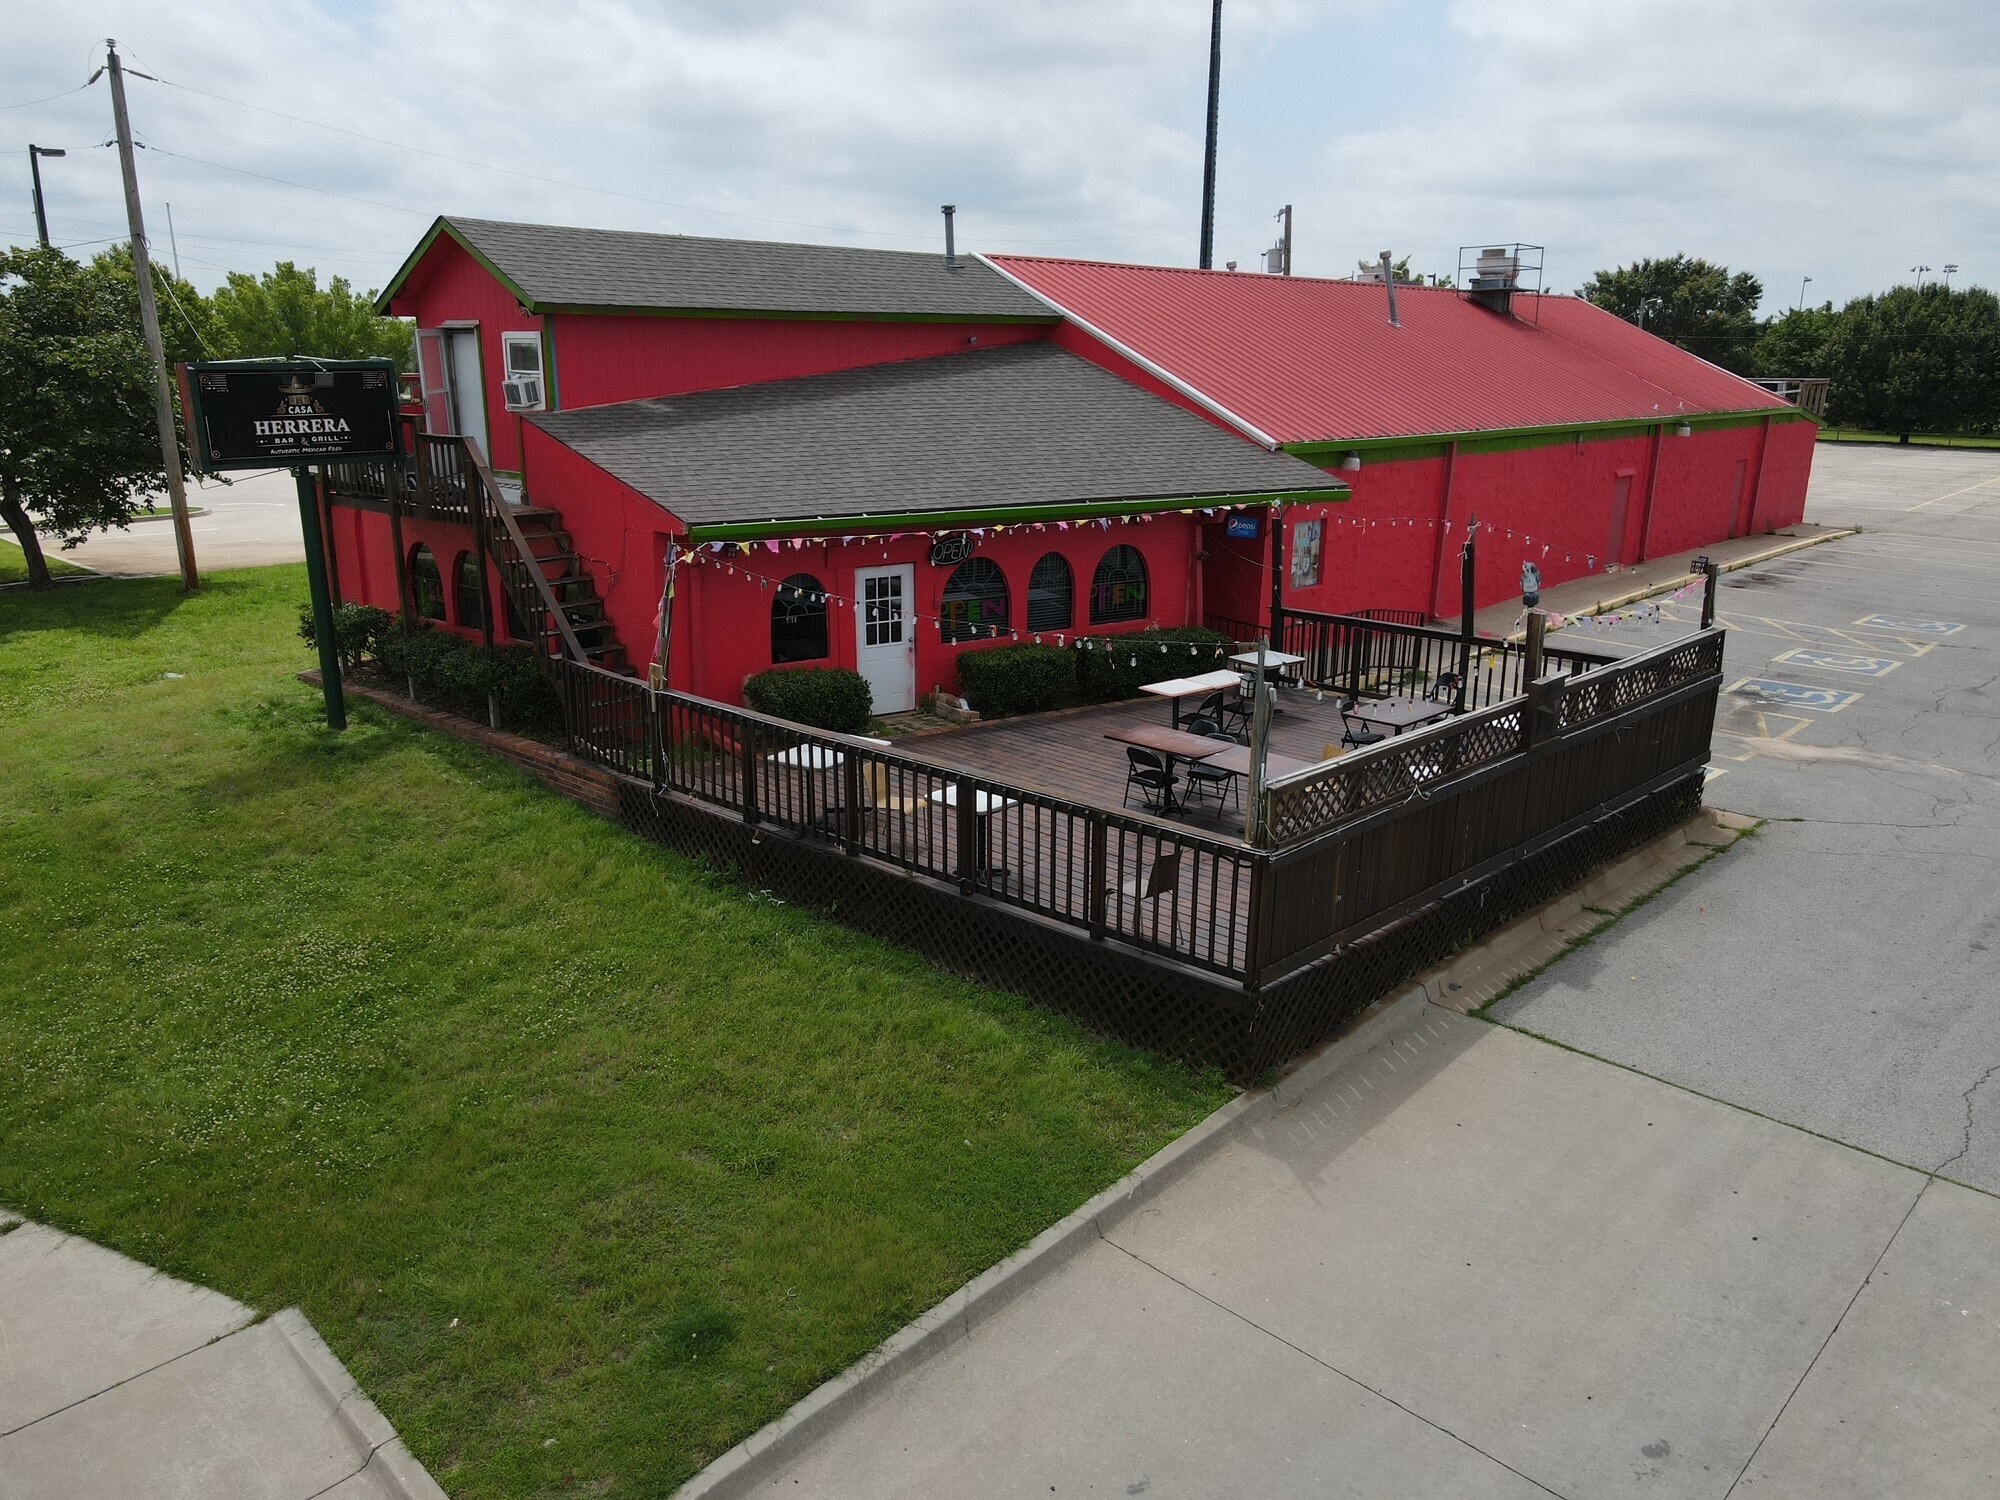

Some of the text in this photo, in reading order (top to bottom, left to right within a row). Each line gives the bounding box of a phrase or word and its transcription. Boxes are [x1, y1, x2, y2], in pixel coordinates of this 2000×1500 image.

[288, 406, 313, 414] CASA
[253, 418, 351, 435] HERRERA
[301, 437, 310, 446] &
[1237, 522, 1256, 531] pepsi
[933, 543, 971, 560] OPEN
